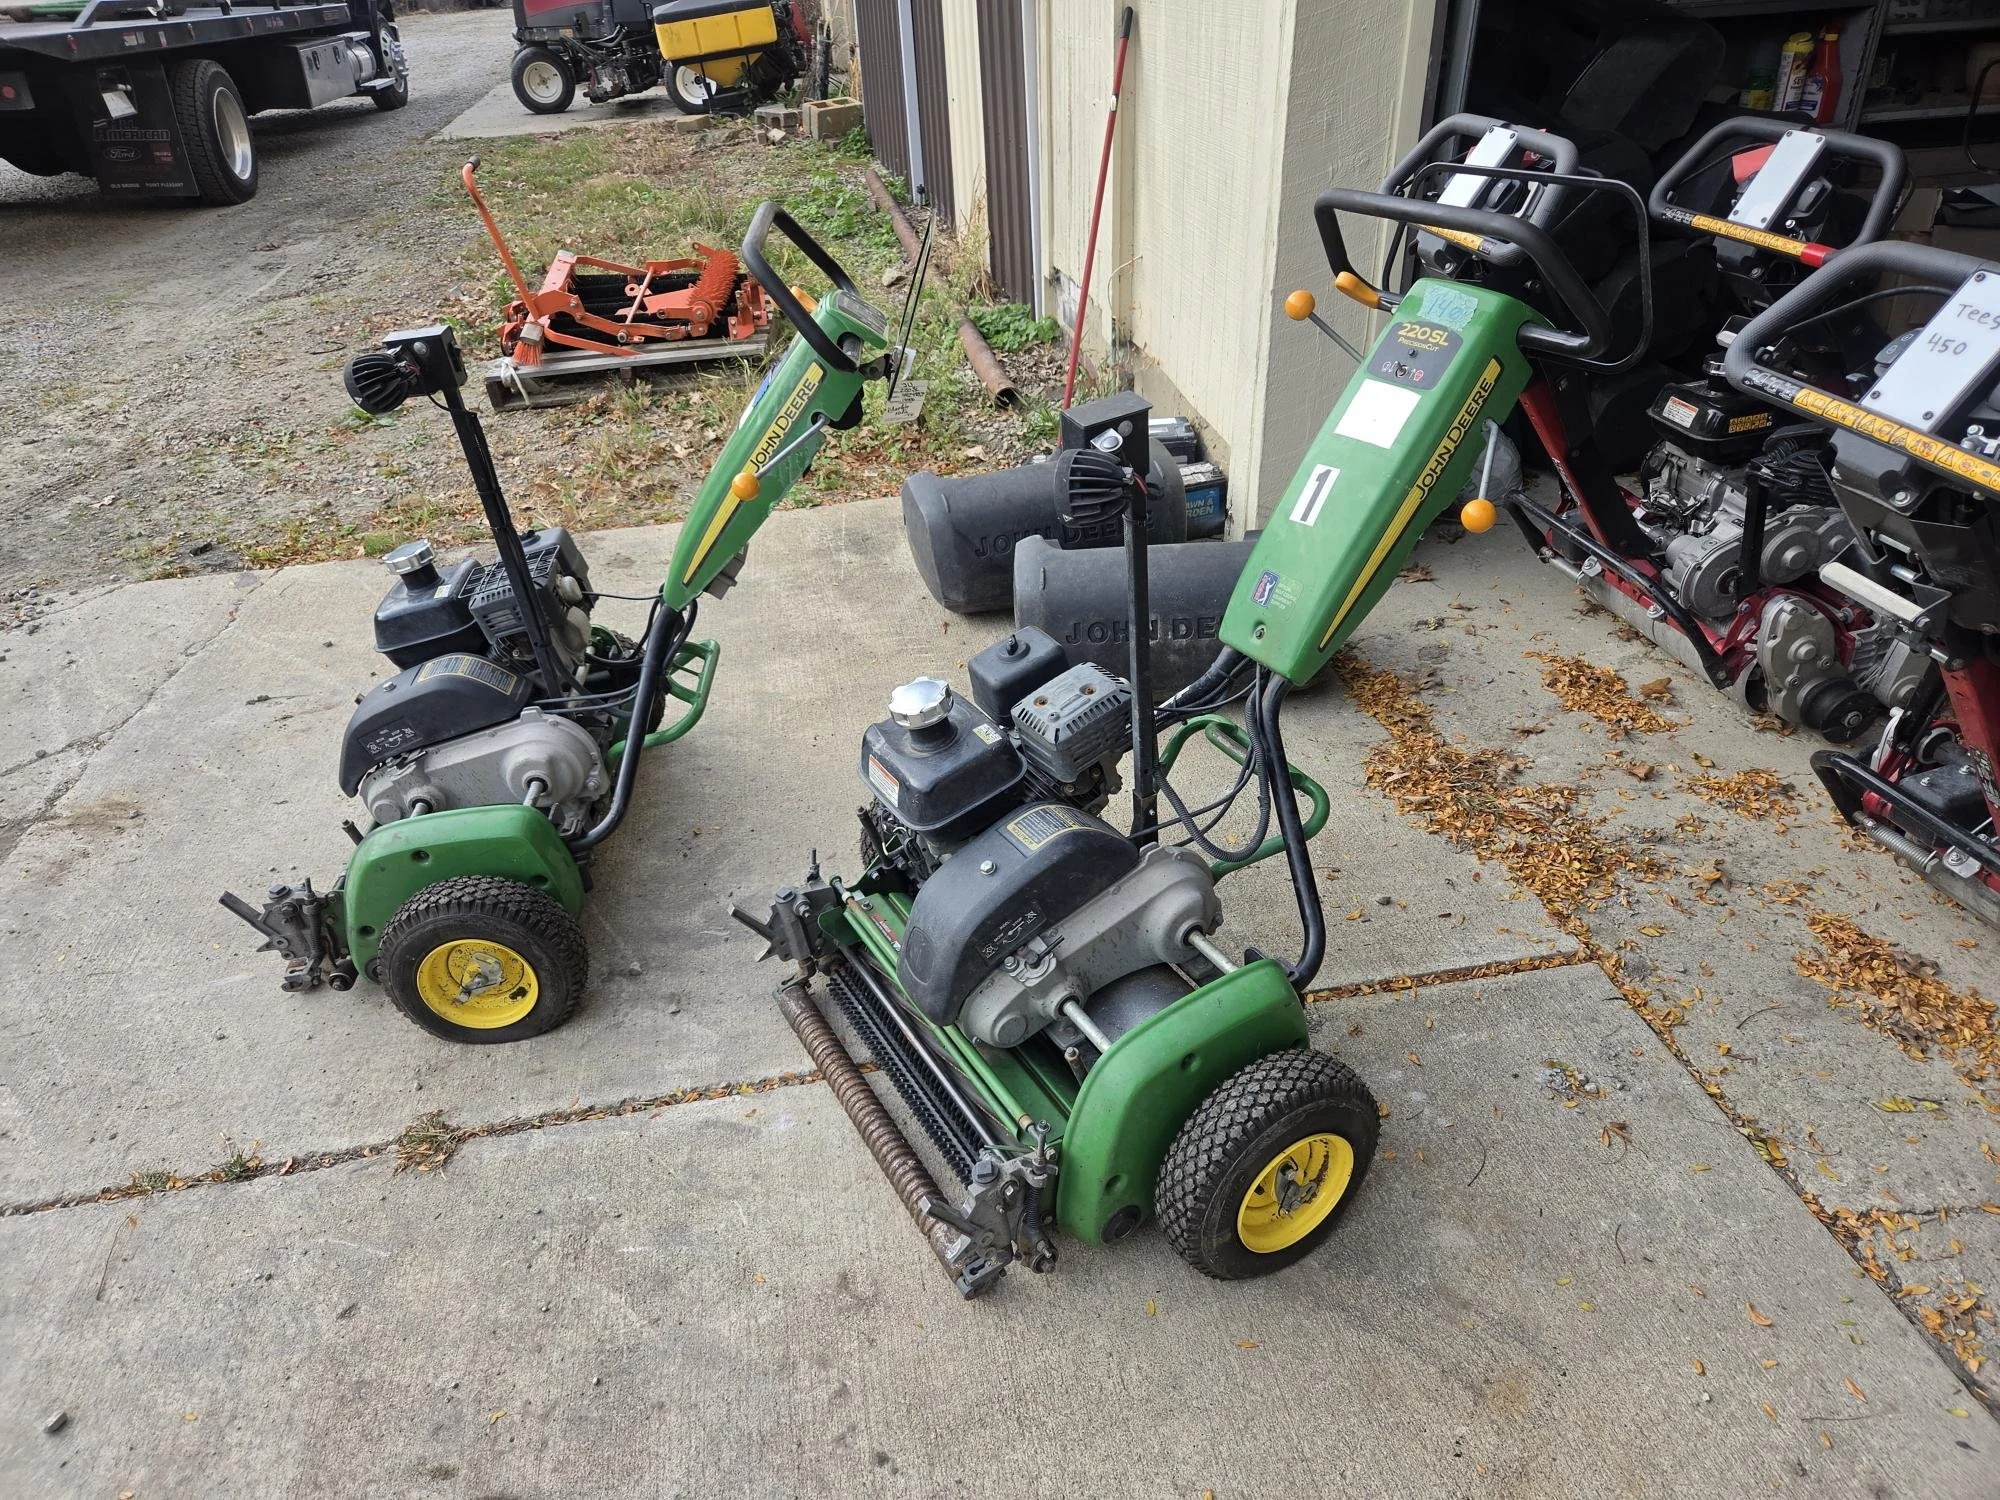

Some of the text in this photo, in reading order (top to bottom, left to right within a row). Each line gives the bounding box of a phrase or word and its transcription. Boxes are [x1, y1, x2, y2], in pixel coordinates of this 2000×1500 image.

[1928, 332, 1967, 355] 450
[750, 378, 816, 473] JOHN DEERE
[1416, 377, 1493, 499] JOHN DEERE
[1300, 468, 1333, 522] 1
